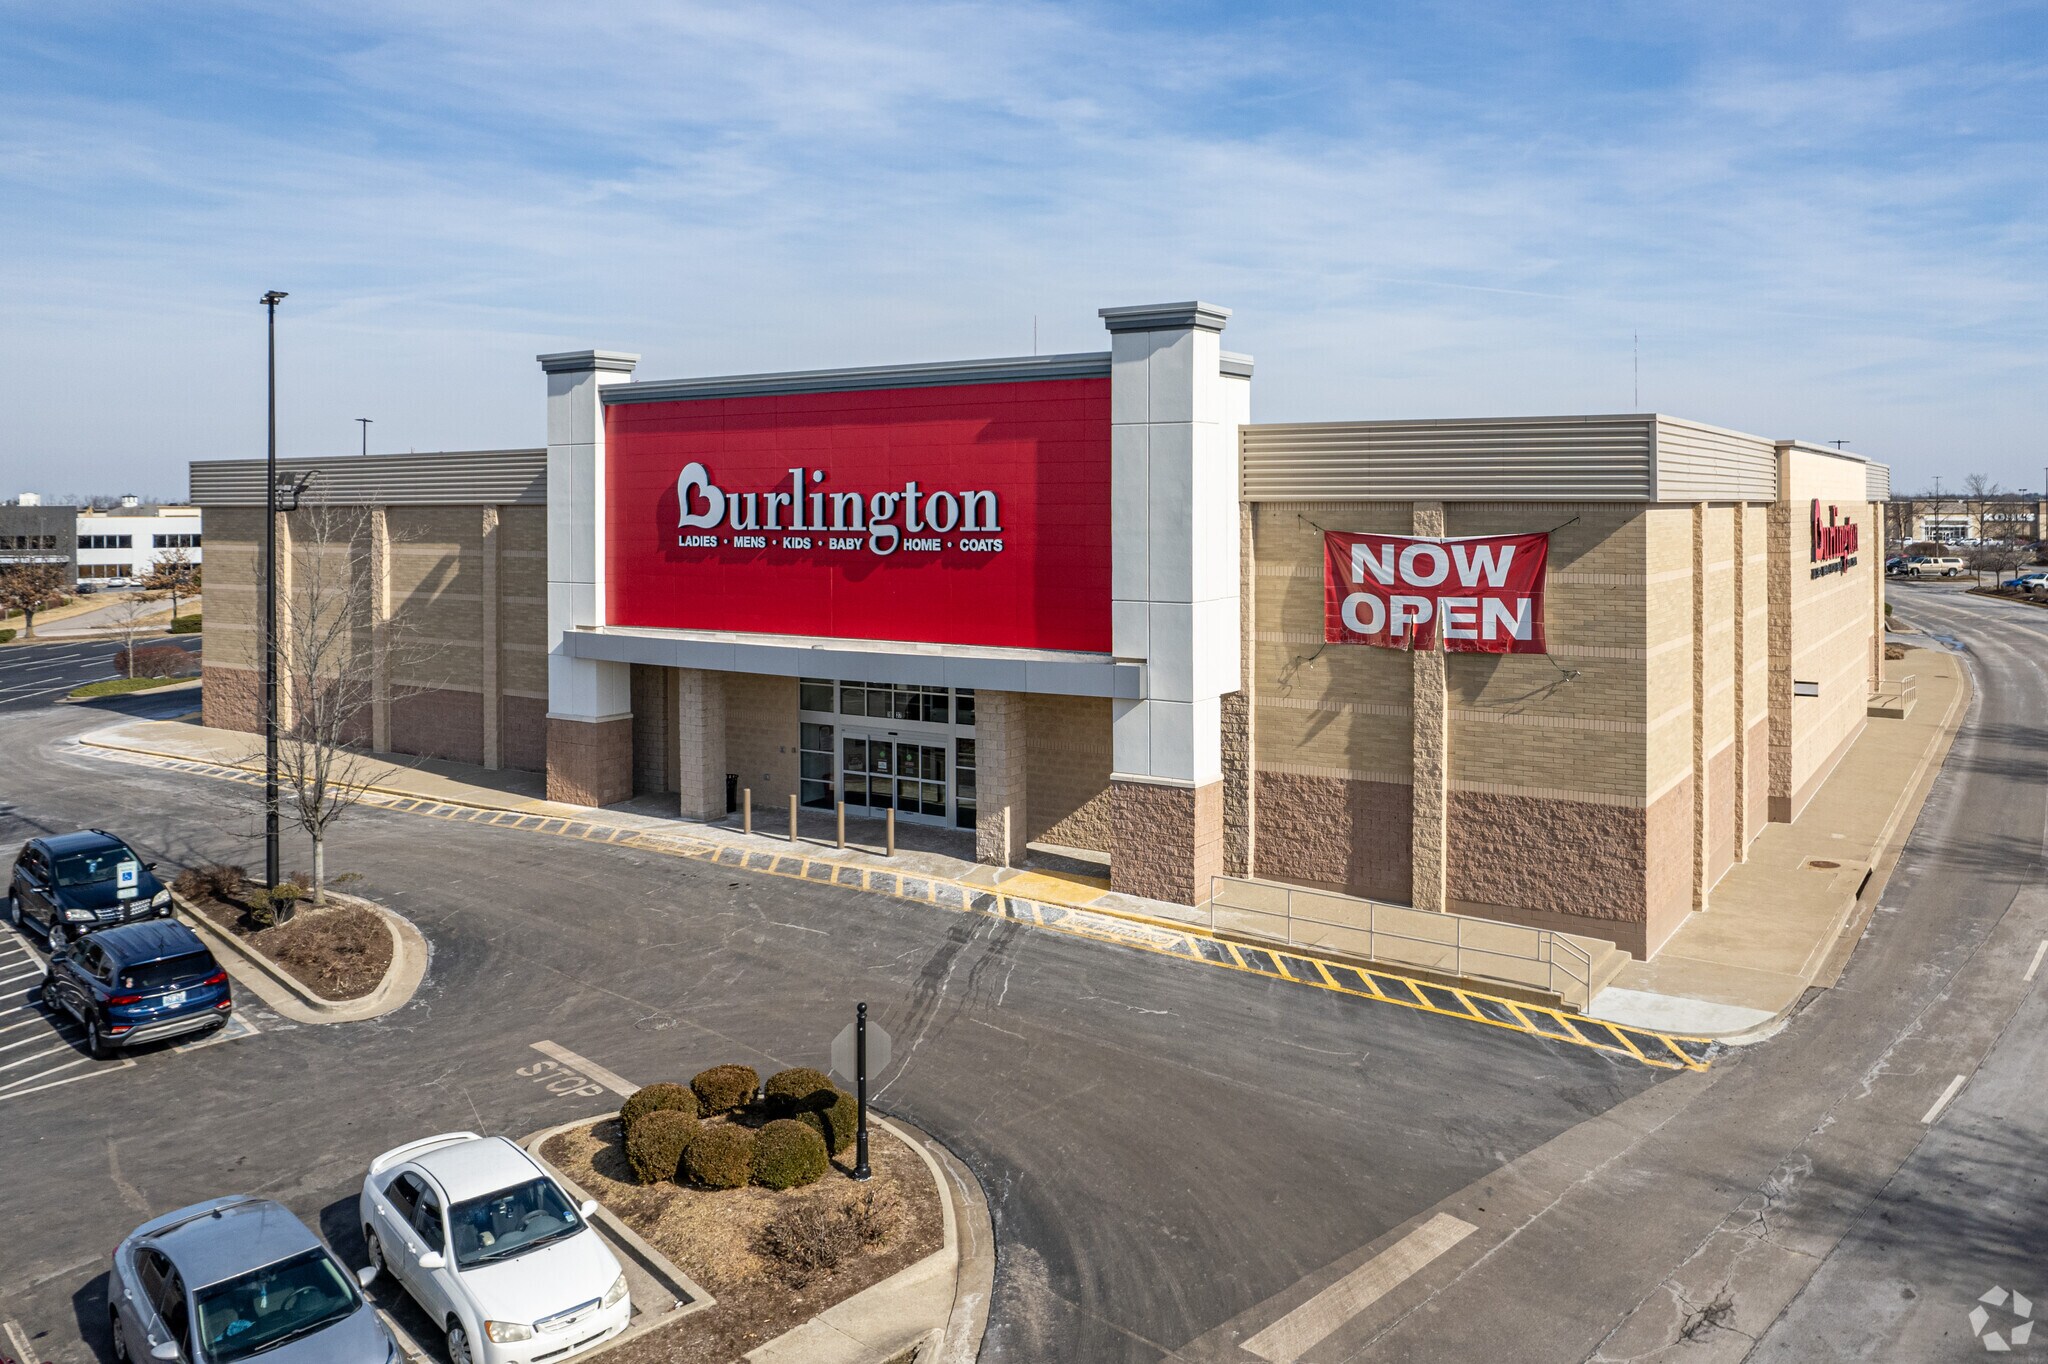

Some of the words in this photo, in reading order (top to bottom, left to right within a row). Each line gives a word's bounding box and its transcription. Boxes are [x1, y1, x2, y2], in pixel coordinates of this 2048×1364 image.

[677, 462, 1002, 556] Burlington
[678, 535, 717, 548] LADIES
[733, 536, 766, 549] MENS
[782, 537, 811, 550] KIDS
[829, 537, 863, 550] BABY
[904, 538, 941, 552] HOME
[959, 538, 1003, 552] COATS
[1351, 543, 1516, 588] NOW
[1341, 592, 1532, 641] OPEN
[515, 1061, 604, 1097] STOP
